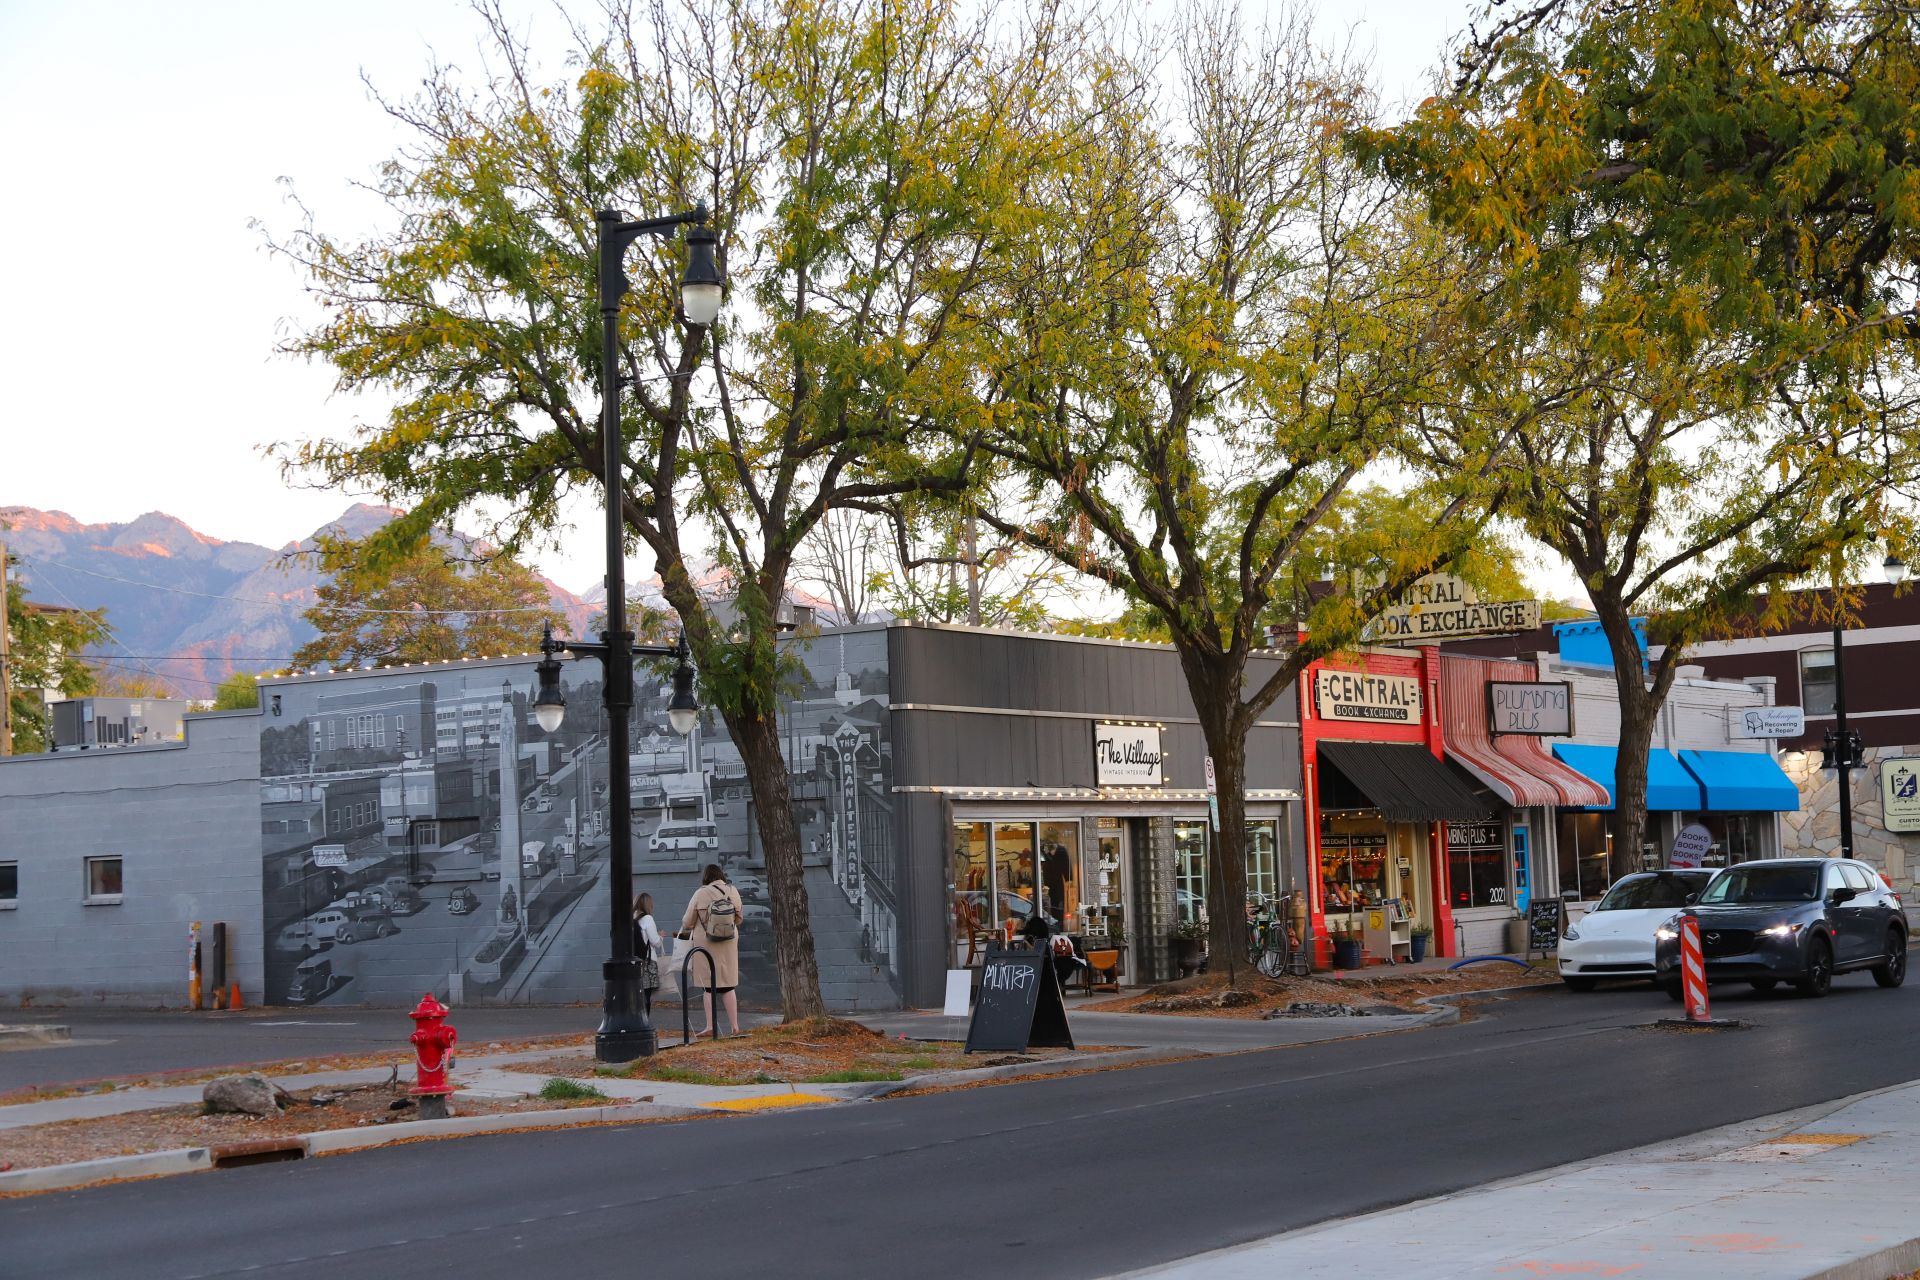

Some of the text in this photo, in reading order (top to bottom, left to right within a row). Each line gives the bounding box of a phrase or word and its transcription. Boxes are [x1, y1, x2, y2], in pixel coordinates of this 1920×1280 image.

[1371, 604, 1526, 636] OOK EXCHANGE
[1329, 674, 1411, 706] CENTRAL
[1496, 689, 1565, 710] PLUMBING
[1336, 705, 1408, 721] BOOK EXCHANGE
[1508, 711, 1540, 730] PLUS
[838, 739, 856, 748] THE
[1097, 737, 1162, 777] The Village
[630, 776, 659, 788] ASATCH
[1470, 828, 1487, 844] PLUS
[1682, 832, 1710, 843] BOOKS
[1677, 841, 1705, 851] BOOKS
[1489, 887, 1506, 903] 2021
